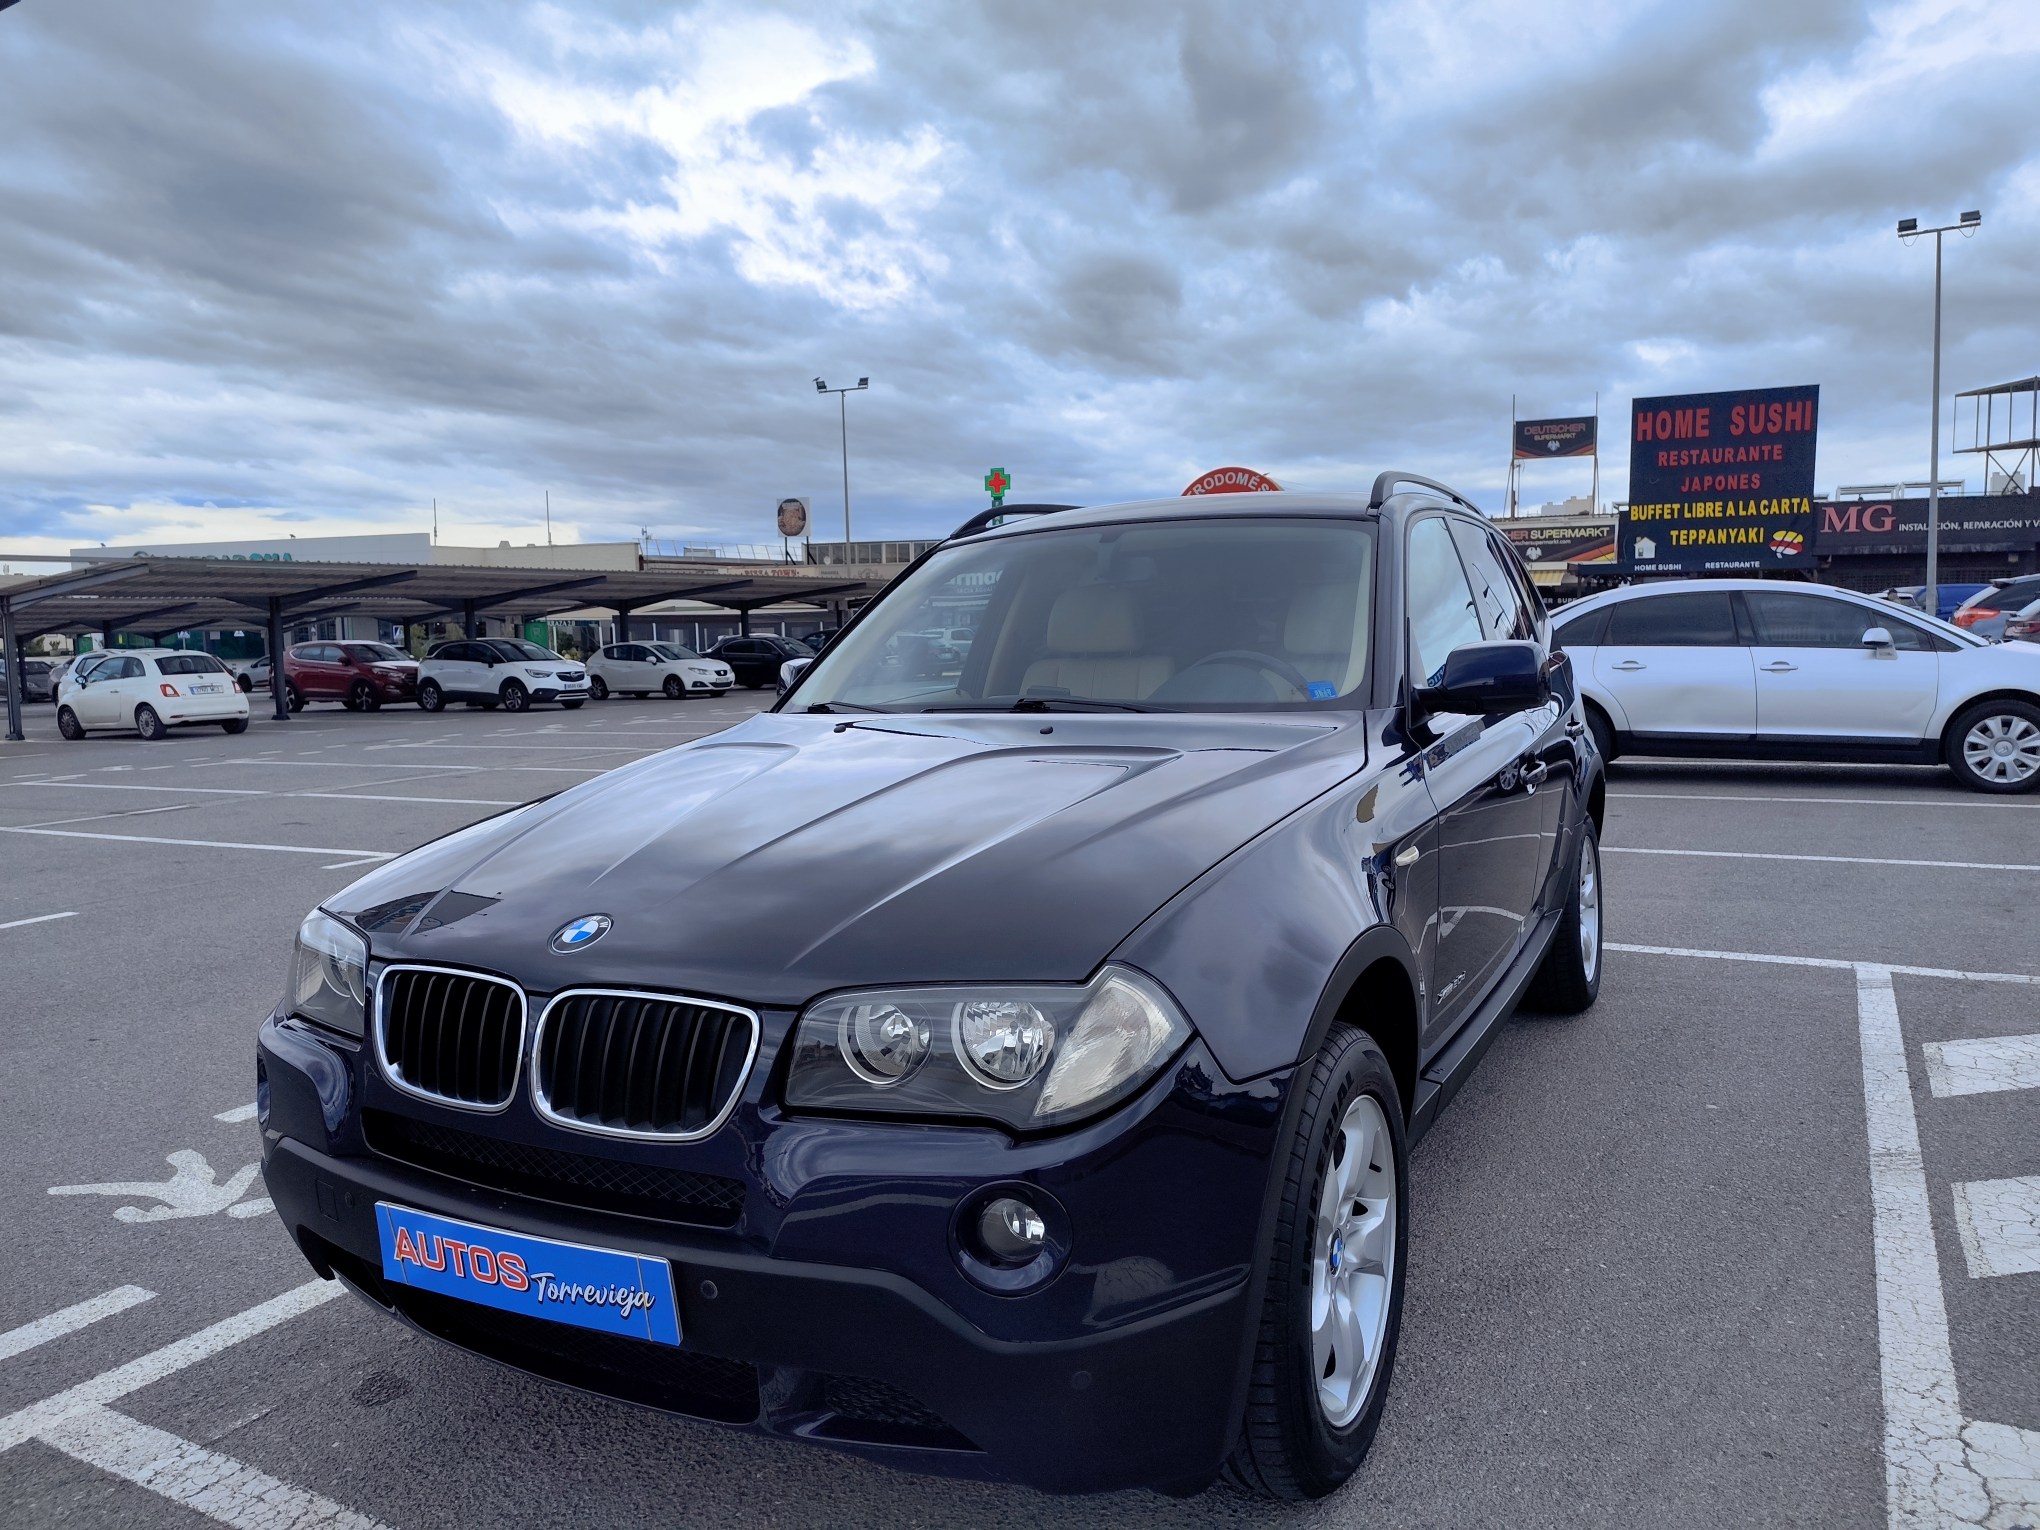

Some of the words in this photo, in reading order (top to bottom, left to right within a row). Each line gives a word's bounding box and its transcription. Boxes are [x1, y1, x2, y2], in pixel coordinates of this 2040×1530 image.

[1524, 423, 1586, 435] DEUTSCHER
[1636, 407, 1710, 442] HOME
[1729, 400, 1813, 436] SUSHI
[1534, 432, 1576, 441] SUPERMARKT
[1658, 444, 1783, 466] RESTAURANTE
[1680, 473, 1761, 492] JAPONES
[1630, 503, 1681, 521] BUFFET
[1684, 501, 1723, 519] LIBRE
[1726, 500, 1736, 517] A
[1738, 500, 1757, 516] LA
[1759, 498, 1811, 515] CARTA
[1820, 504, 1897, 533] MG
[1530, 527, 1610, 539] SUPERMARKT
[1963, 518, 2024, 530] REPARACIÓN
[2024, 520, 2032, 529] Y
[1670, 527, 1764, 546] TEPPANYAKI
[1657, 563, 1682, 571] SUSHI
[1705, 561, 1760, 569] RESTAURANTE
[394, 1226, 530, 1292] AUTOS
[531, 1272, 656, 1317] Torrevieja
